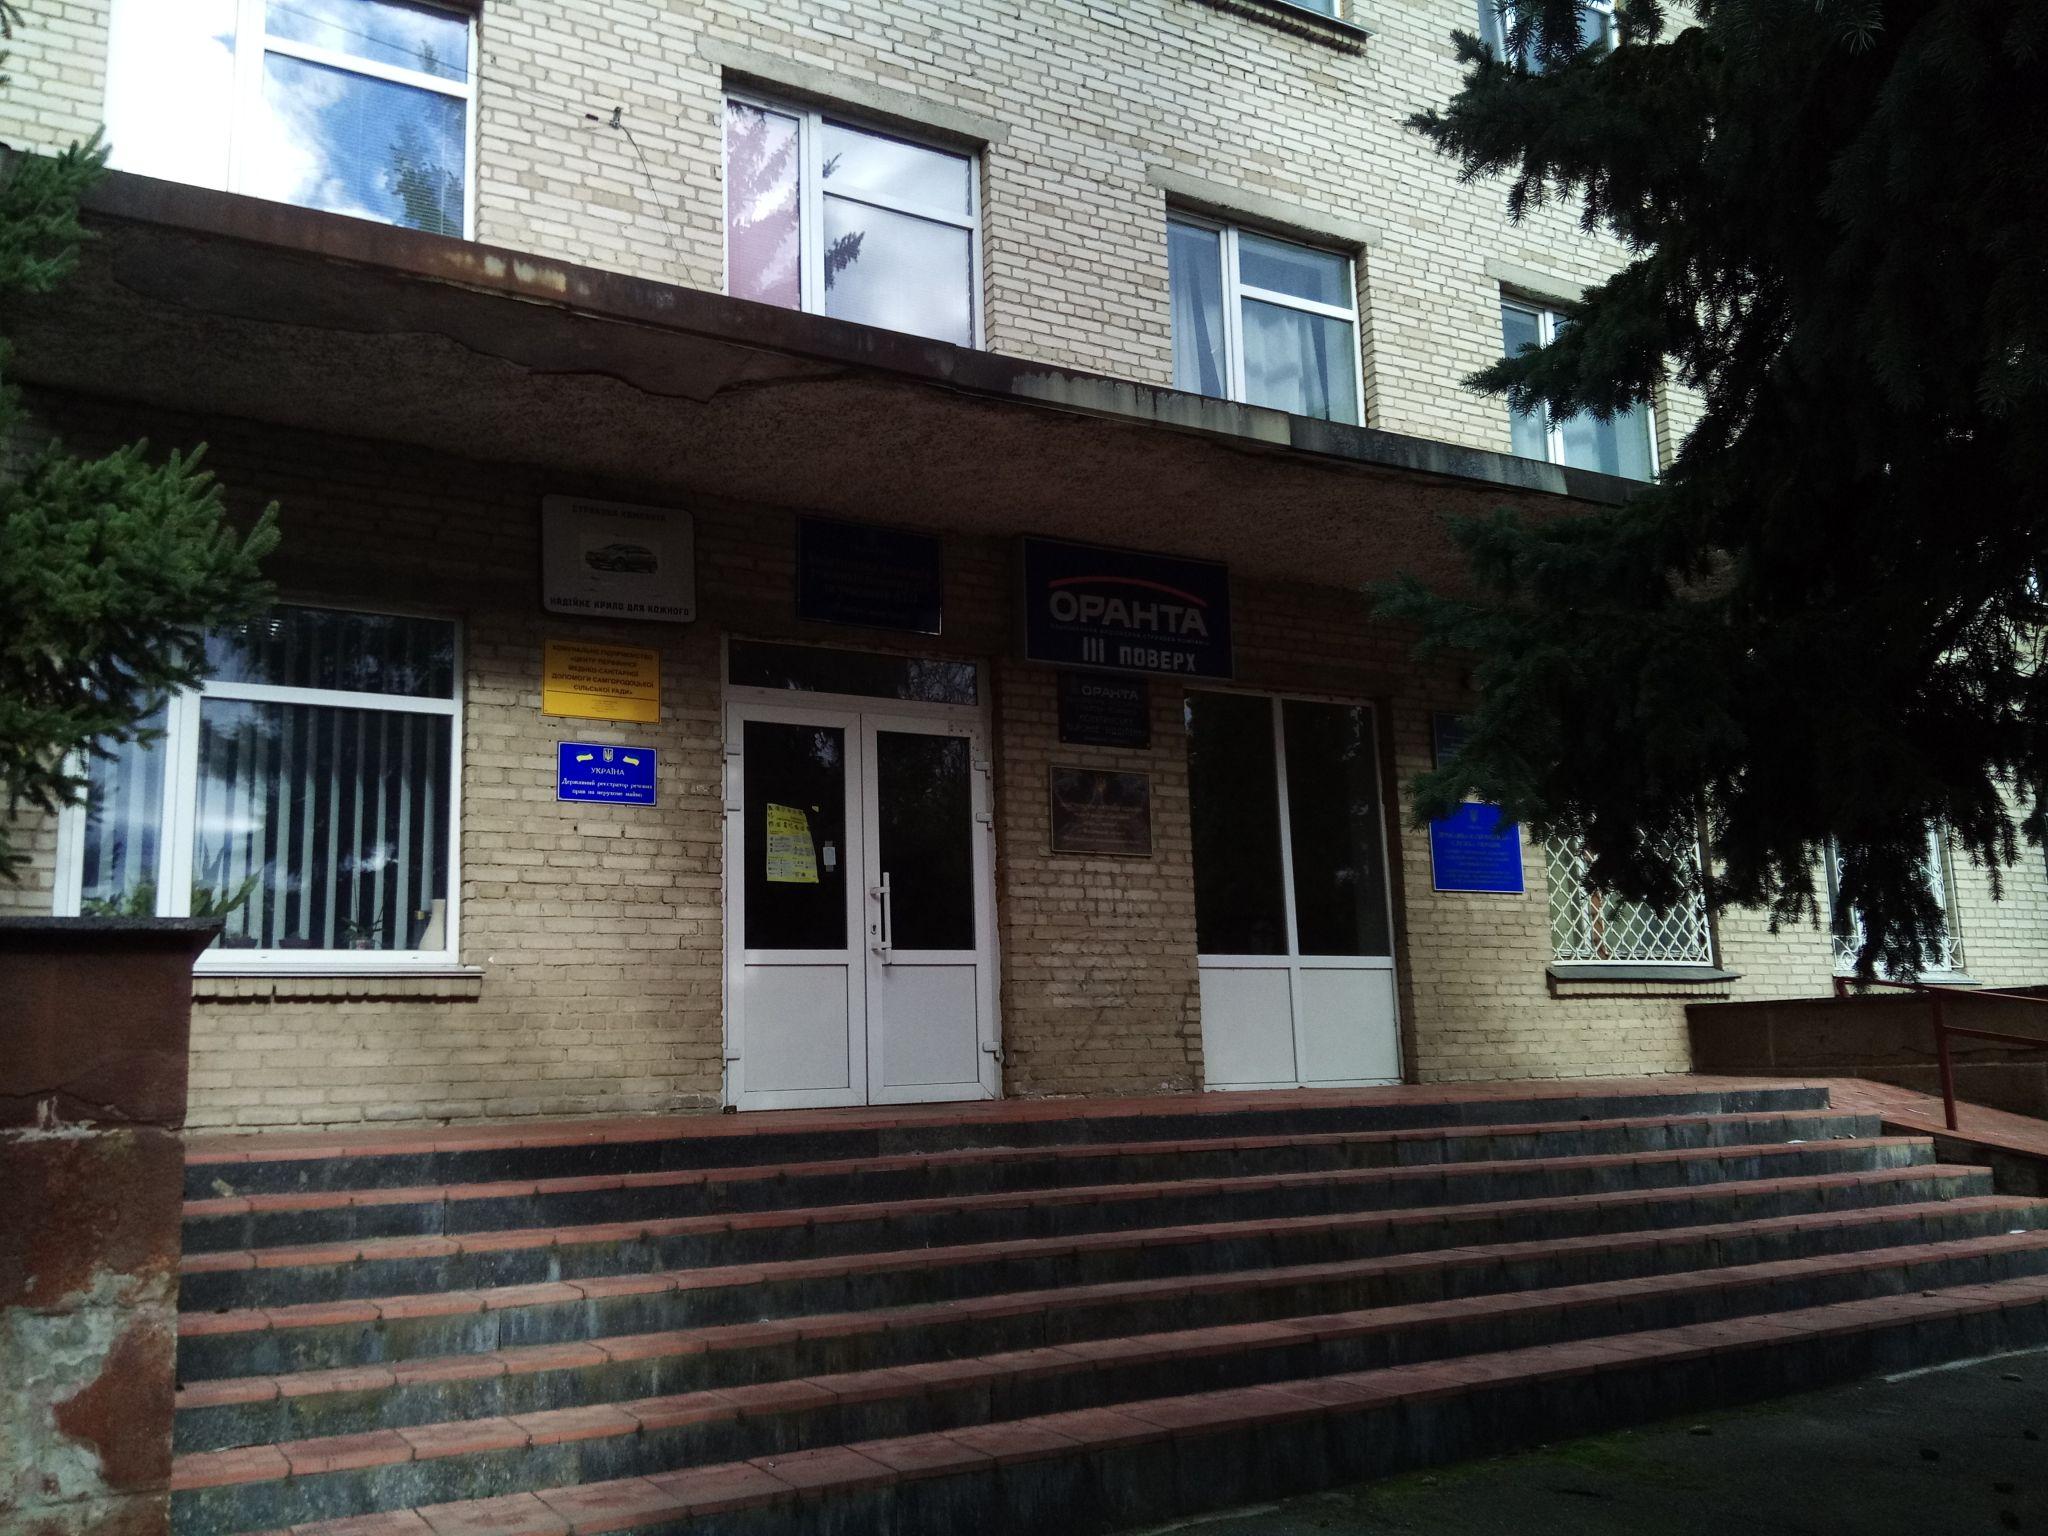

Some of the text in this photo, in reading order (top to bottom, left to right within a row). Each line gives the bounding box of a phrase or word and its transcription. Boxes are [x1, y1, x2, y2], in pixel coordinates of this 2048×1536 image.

[550, 597, 689, 616] НАДІЙНЕ КРИЛО ДЛЯ КОЖНОГО
[1049, 590, 1209, 637] ОРАНТА
[1119, 645, 1196, 673] ПОВЕРХ
[552, 672, 591, 682] ДОПОМОГИ
[1080, 685, 1138, 700] ОРАНТА
[590, 767, 625, 776] УКРАЇНА
